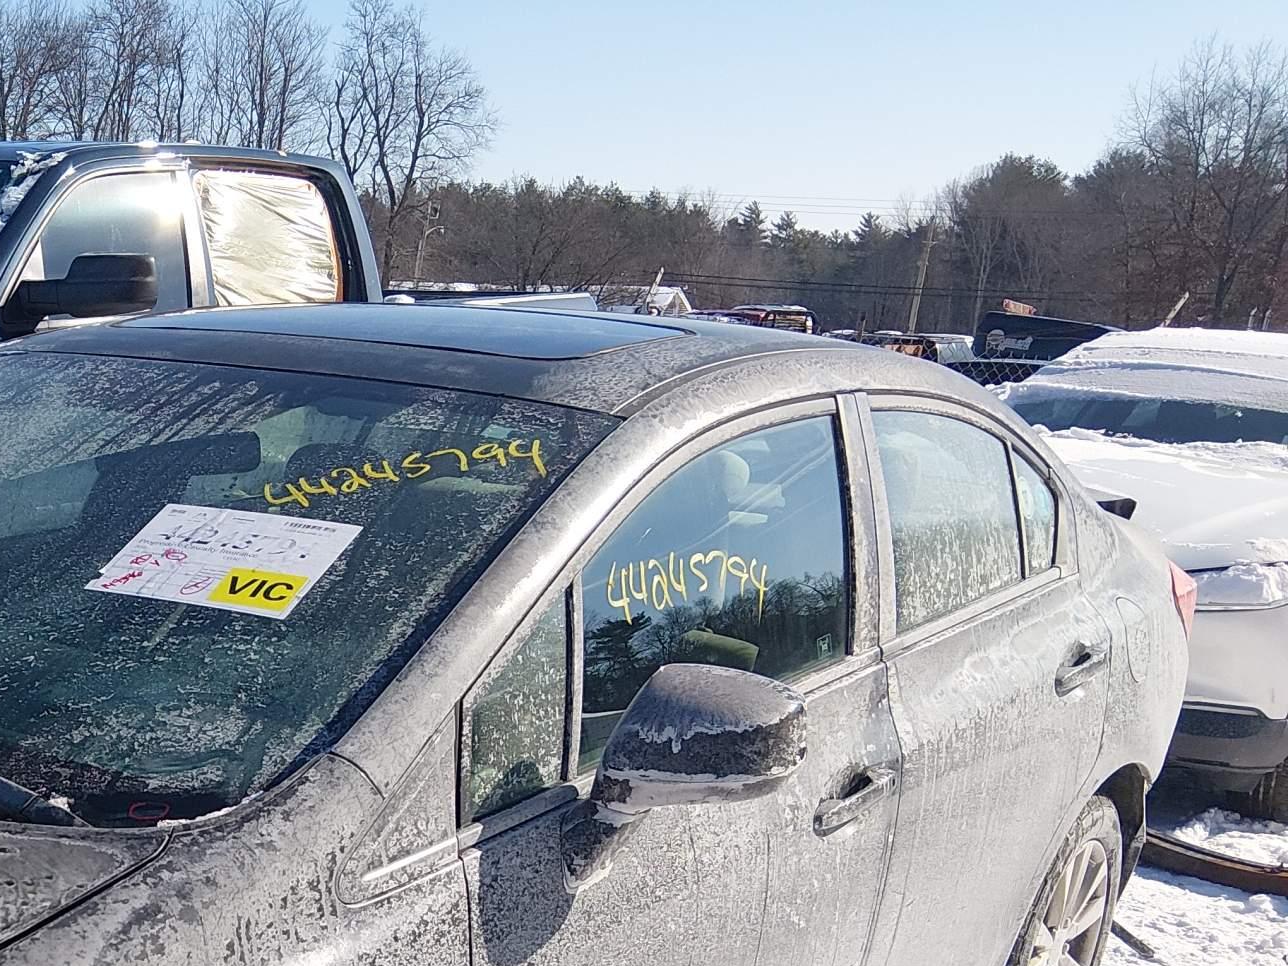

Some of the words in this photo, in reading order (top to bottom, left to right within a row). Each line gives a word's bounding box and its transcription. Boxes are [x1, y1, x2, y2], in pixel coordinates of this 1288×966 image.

[263, 438, 548, 508] 44245794
[228, 575, 295, 602] VIC
[607, 550, 769, 626] 44245794
